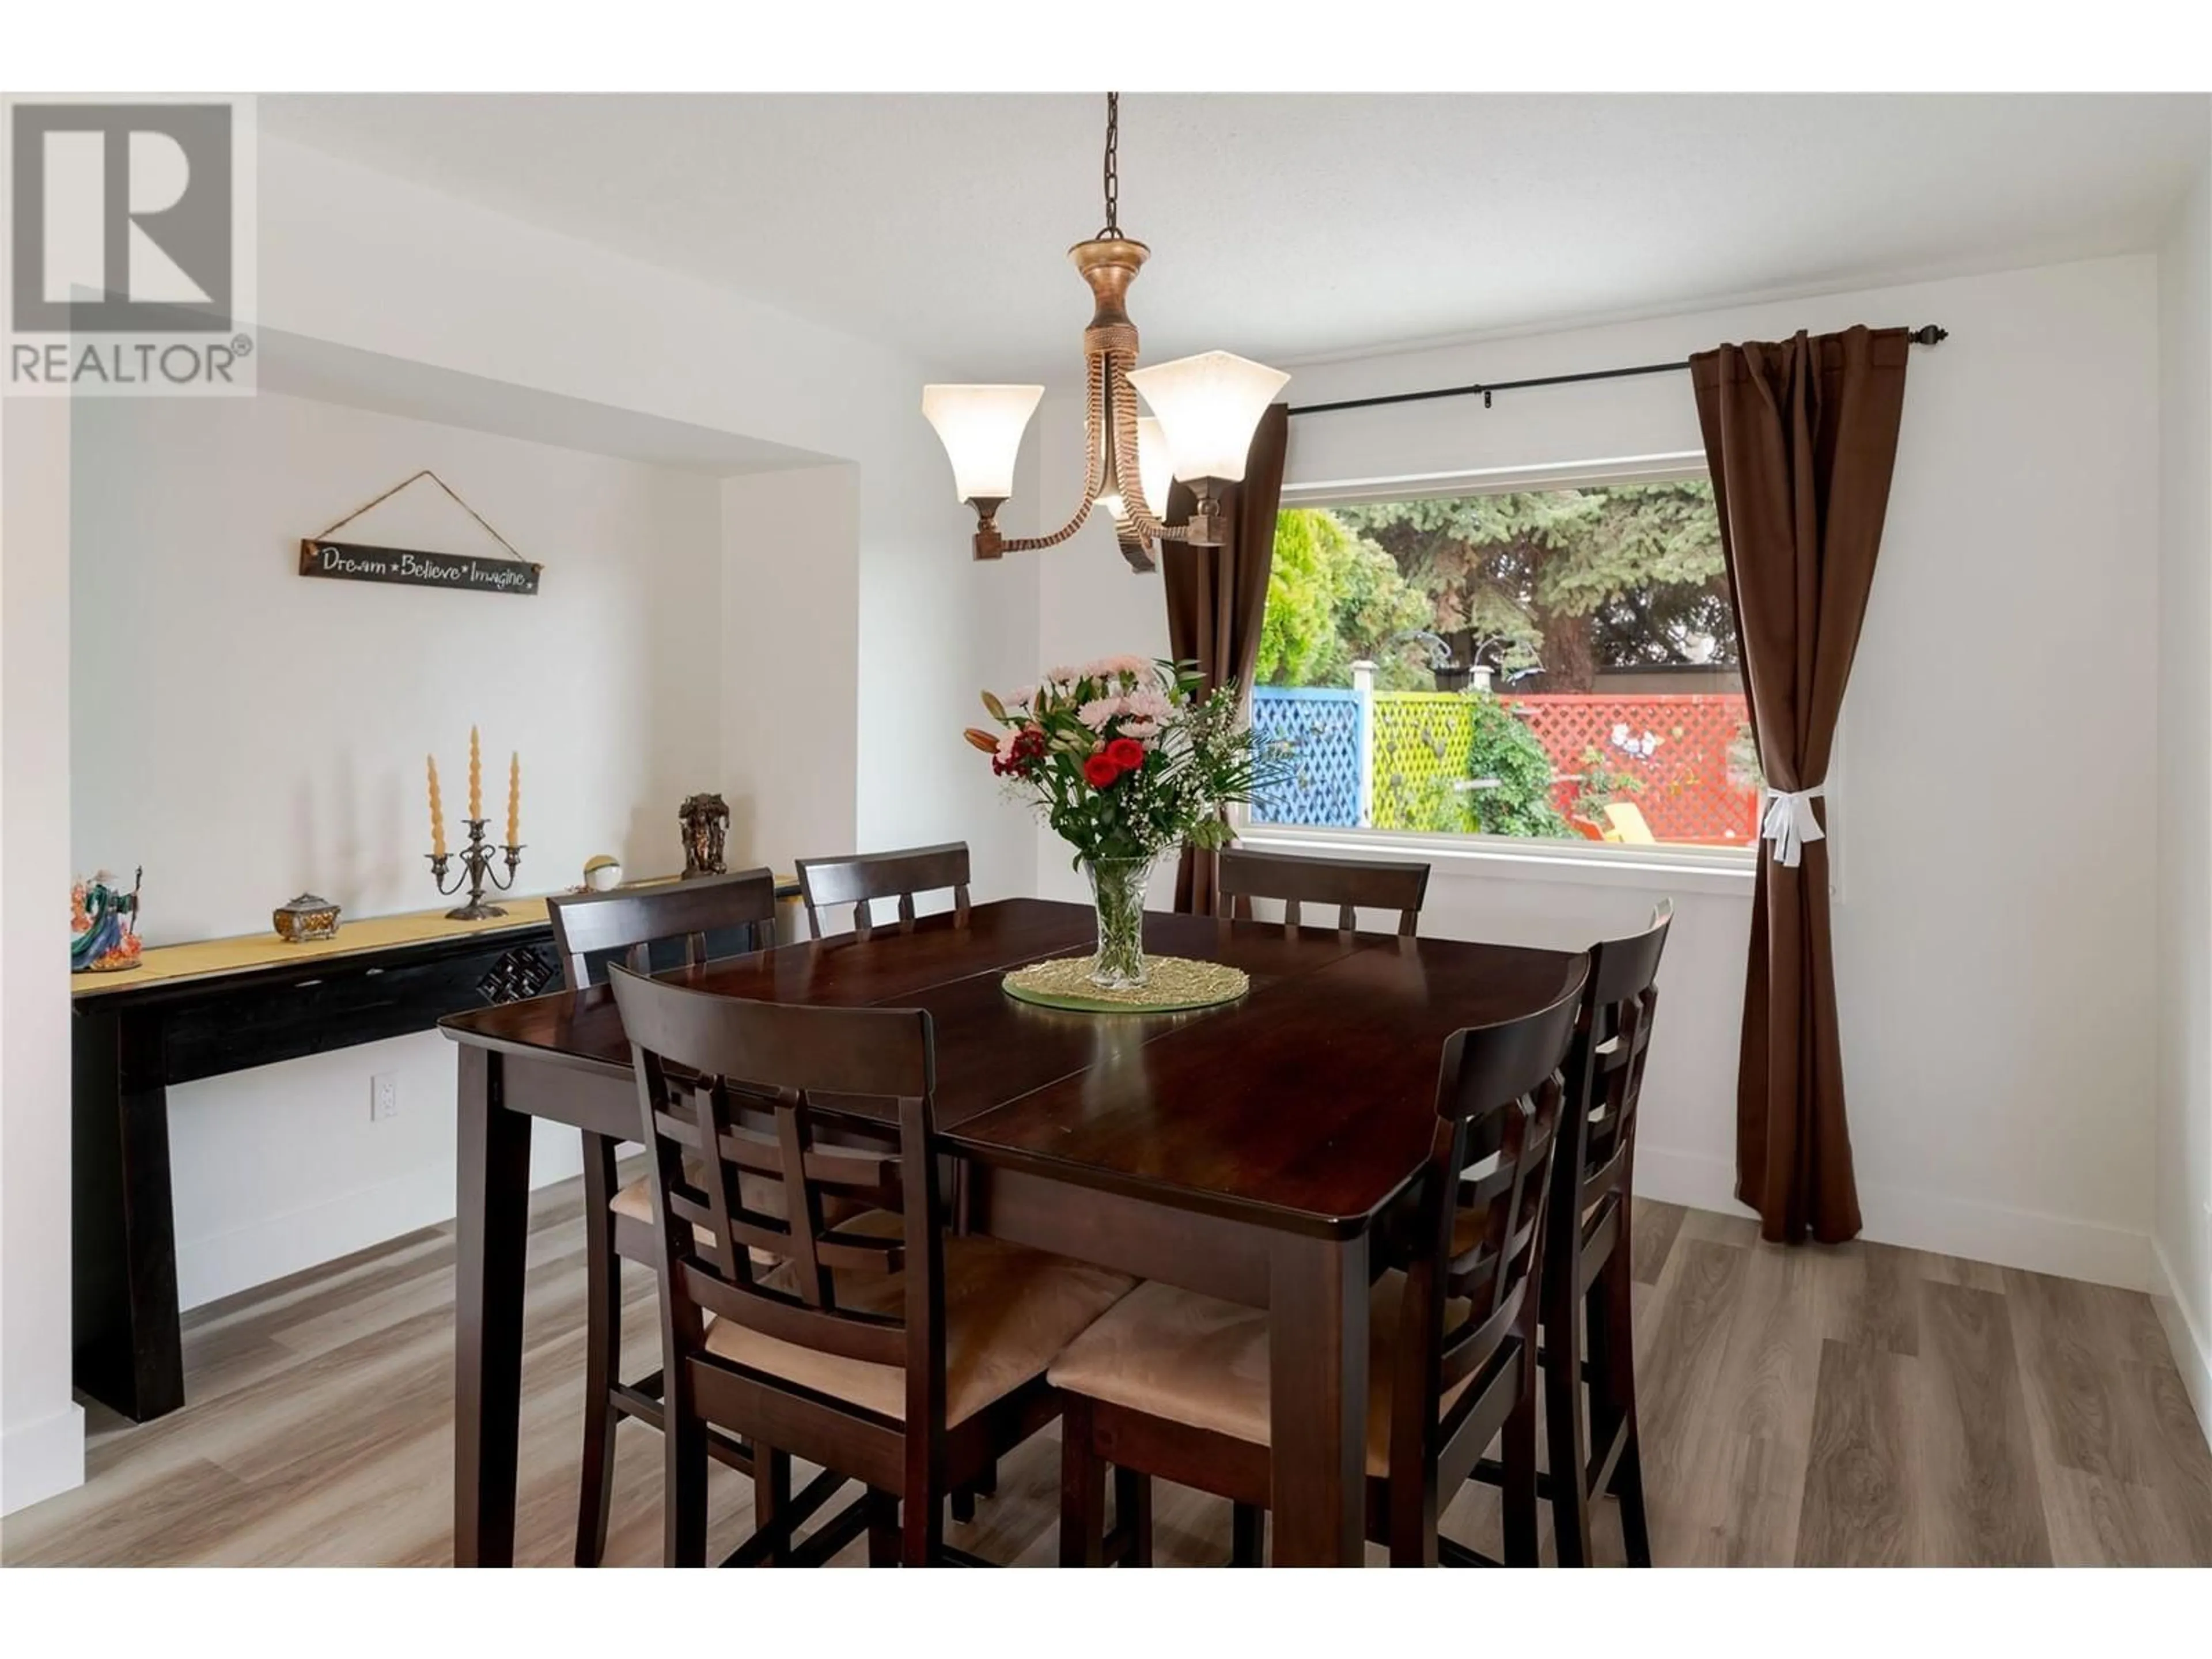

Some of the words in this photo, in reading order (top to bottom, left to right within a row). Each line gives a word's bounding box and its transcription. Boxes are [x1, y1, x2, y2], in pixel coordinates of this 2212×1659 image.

[322, 547, 386, 574] Dream
[401, 554, 461, 580] Believe
[471, 561, 525, 590] Imagine
